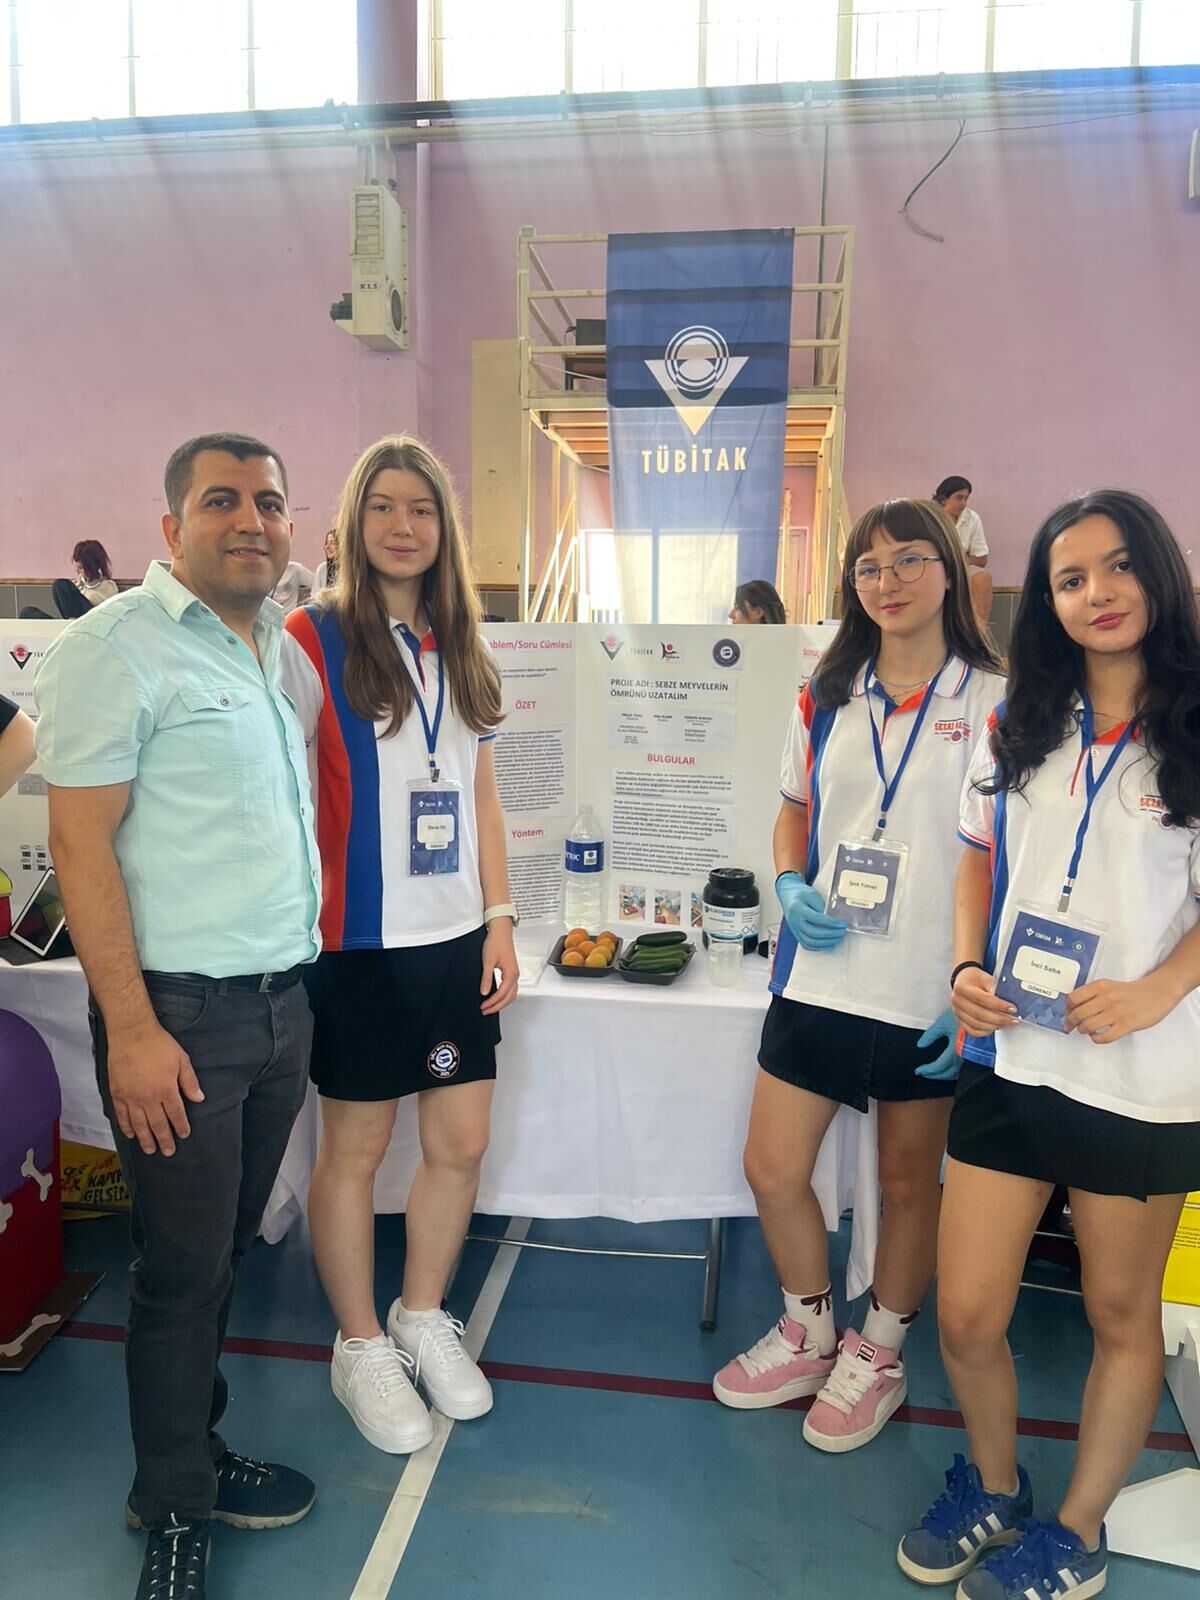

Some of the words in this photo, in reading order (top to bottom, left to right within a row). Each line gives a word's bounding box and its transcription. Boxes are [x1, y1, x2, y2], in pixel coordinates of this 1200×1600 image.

[641, 443, 748, 475] TÜBİTAK
[539, 639, 572, 649] Cümlesi
[610, 678, 634, 687] PROJE
[635, 679, 649, 687] ADI
[655, 680, 677, 689] SEBZE
[679, 681, 729, 691] MEYVELERİN
[610, 688, 647, 698] ÖMRÜNÜ
[648, 691, 688, 700] UZATALIM
[515, 699, 537, 710] ÖZET
[647, 753, 696, 765] BULGULAR
[511, 829, 544, 839] Yöntem
